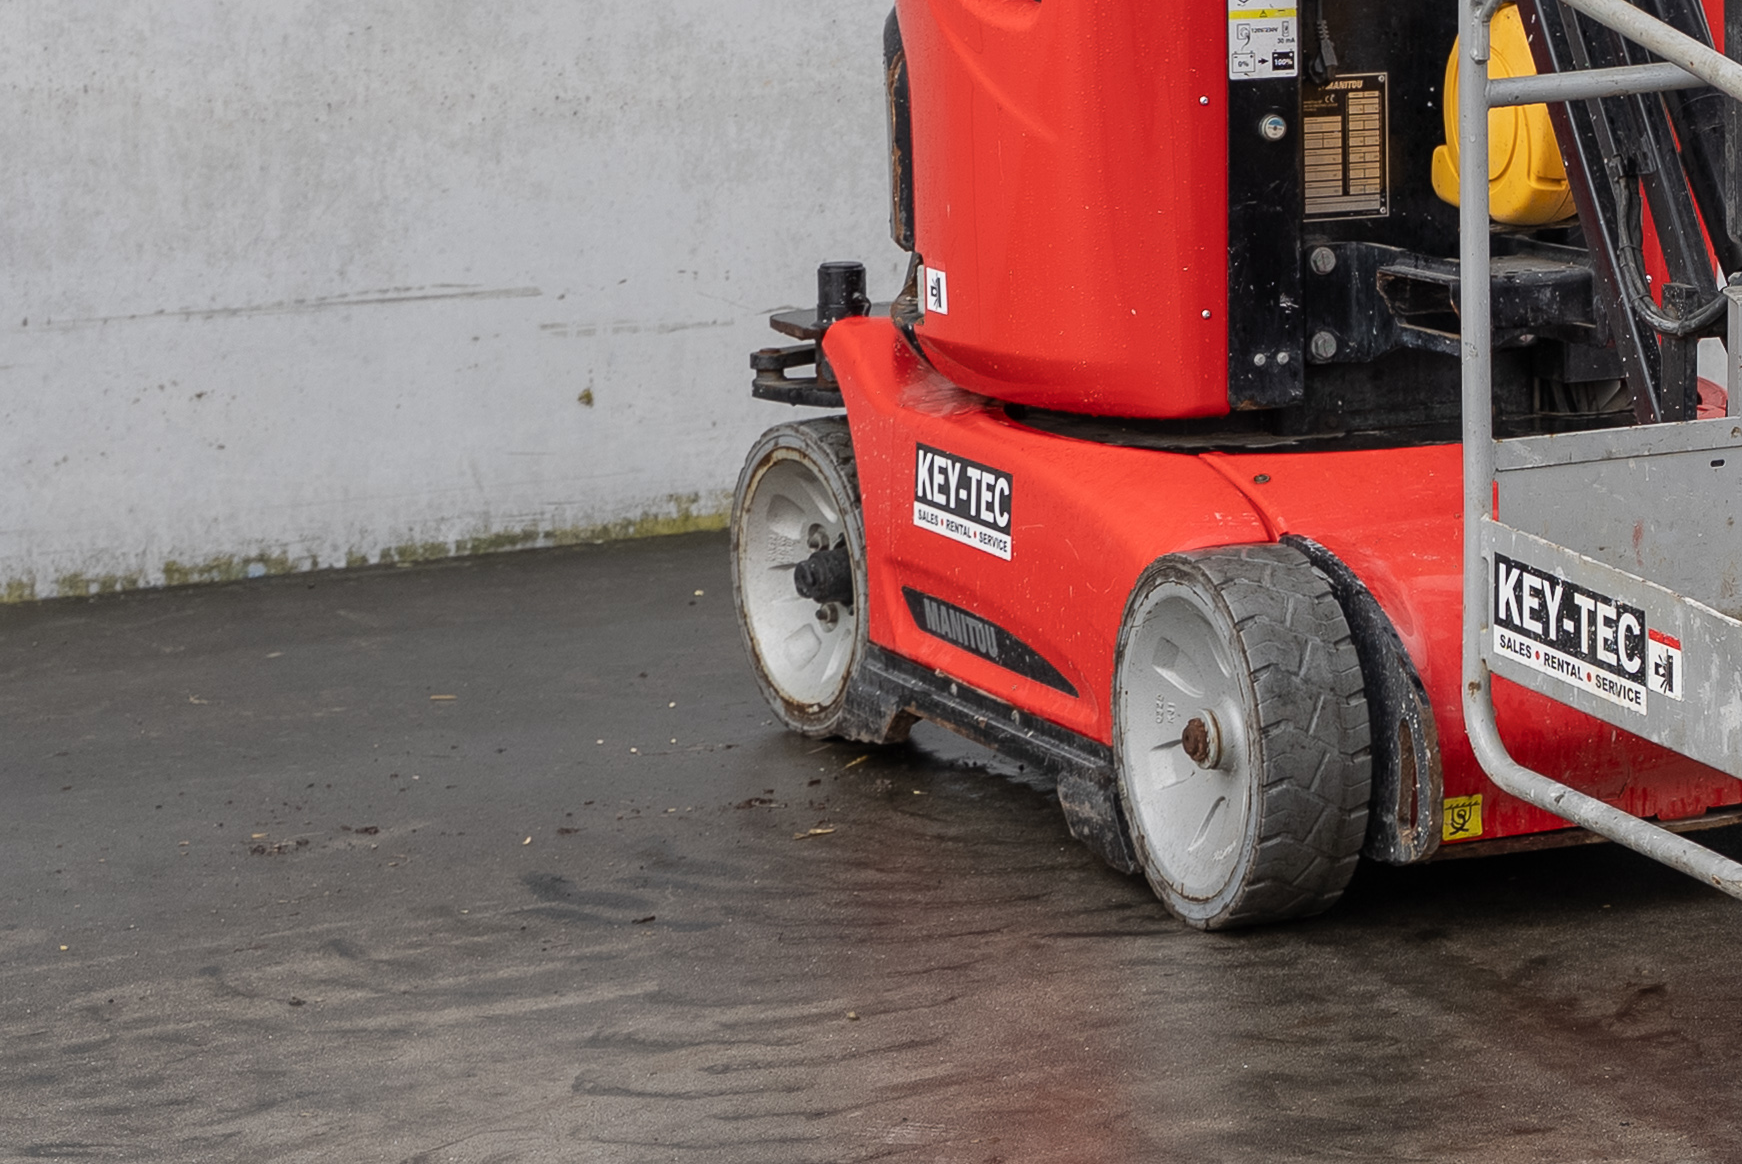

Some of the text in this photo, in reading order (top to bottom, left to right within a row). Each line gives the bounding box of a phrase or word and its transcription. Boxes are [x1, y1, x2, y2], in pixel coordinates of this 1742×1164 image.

[1274, 58, 1293, 66] 100%
[917, 449, 1010, 528] KEY-TEC
[918, 509, 1008, 553] SALES RENTAL SERVICE
[923, 598, 999, 658] MANITOU
[1499, 562, 1642, 674] KEY-TEC
[1500, 634, 1641, 706] SALES RENTAL SERVICE
